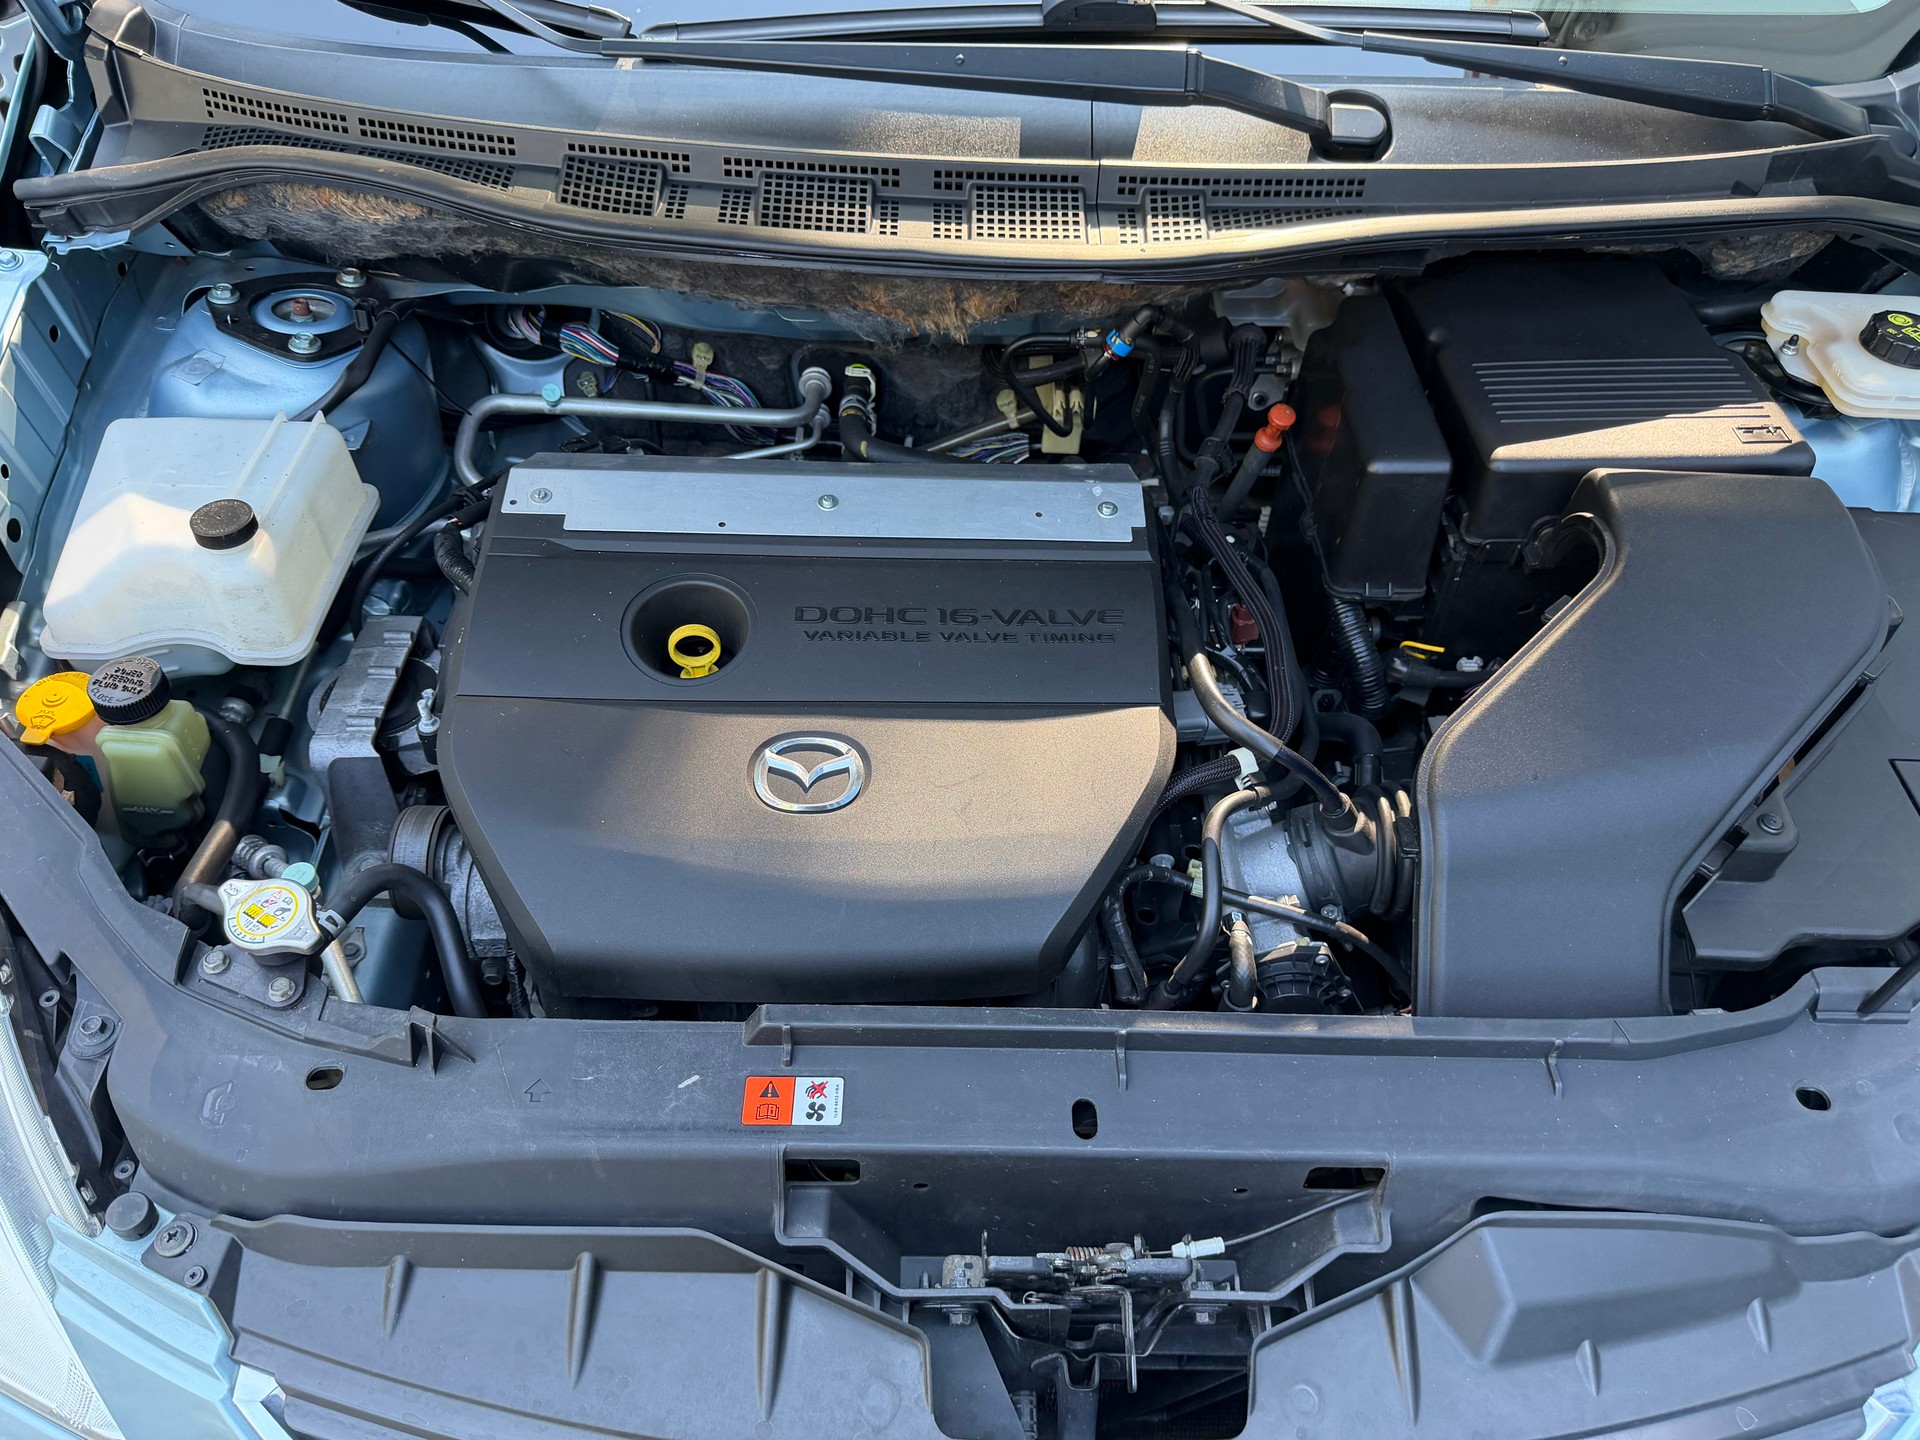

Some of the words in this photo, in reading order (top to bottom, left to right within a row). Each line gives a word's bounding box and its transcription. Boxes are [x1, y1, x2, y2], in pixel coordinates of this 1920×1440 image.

[794, 605, 927, 626] DOHC
[935, 607, 1125, 627] 16-VALVE
[803, 630, 930, 642] VARIABLE
[938, 632, 1018, 644] VALVE
[1024, 632, 1116, 644] TIMING
[92, 679, 119, 690] FLUID
[90, 687, 115, 704] CLOSE
[231, 924, 247, 939] FL22
